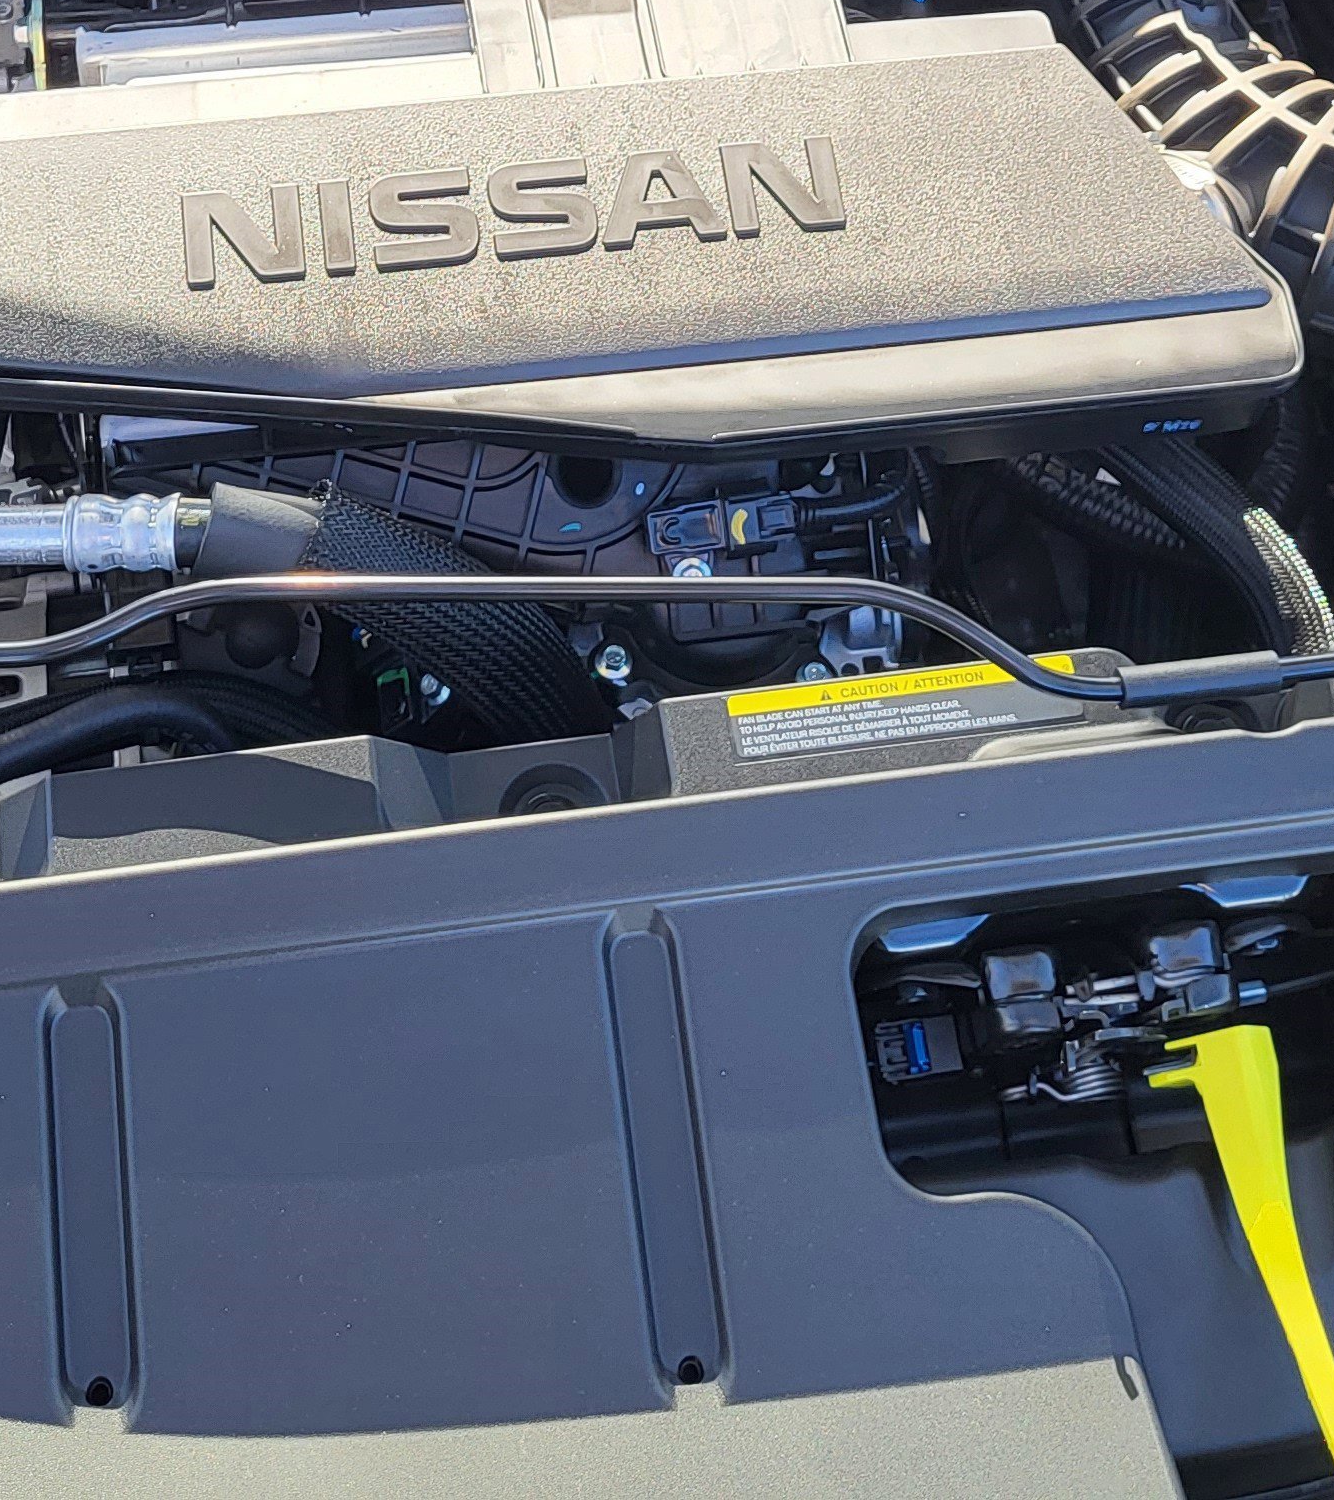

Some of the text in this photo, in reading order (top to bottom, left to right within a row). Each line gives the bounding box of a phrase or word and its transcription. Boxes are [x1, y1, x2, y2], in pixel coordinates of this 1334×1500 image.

[178, 135, 847, 290] NISSAN
[839, 681, 898, 699] CAUTION
[913, 670, 984, 690] ATTENTION
[737, 716, 755, 726] FAN
[784, 710, 803, 720] CAN
[804, 706, 831, 718] START
[831, 704, 843, 714] AT
[843, 702, 861, 712] ANY
[738, 726, 753, 735] TO
[753, 722, 775, 733] HELP
[776, 719, 803, 730] AVOID
[803, 716, 849, 727] PERSONAL
[900, 702, 931, 714] HANDS
[741, 736, 753, 746] LE
[753, 729, 808, 744] VENTILATEUR
[841, 724, 854, 734] DE
[909, 714, 932, 725] TOUT
[743, 745, 769, 756] POUR
[799, 737, 827, 749] TOUTE
[874, 730, 887, 739] NE
[888, 726, 905, 737] PAS
[971, 716, 989, 727] LES
